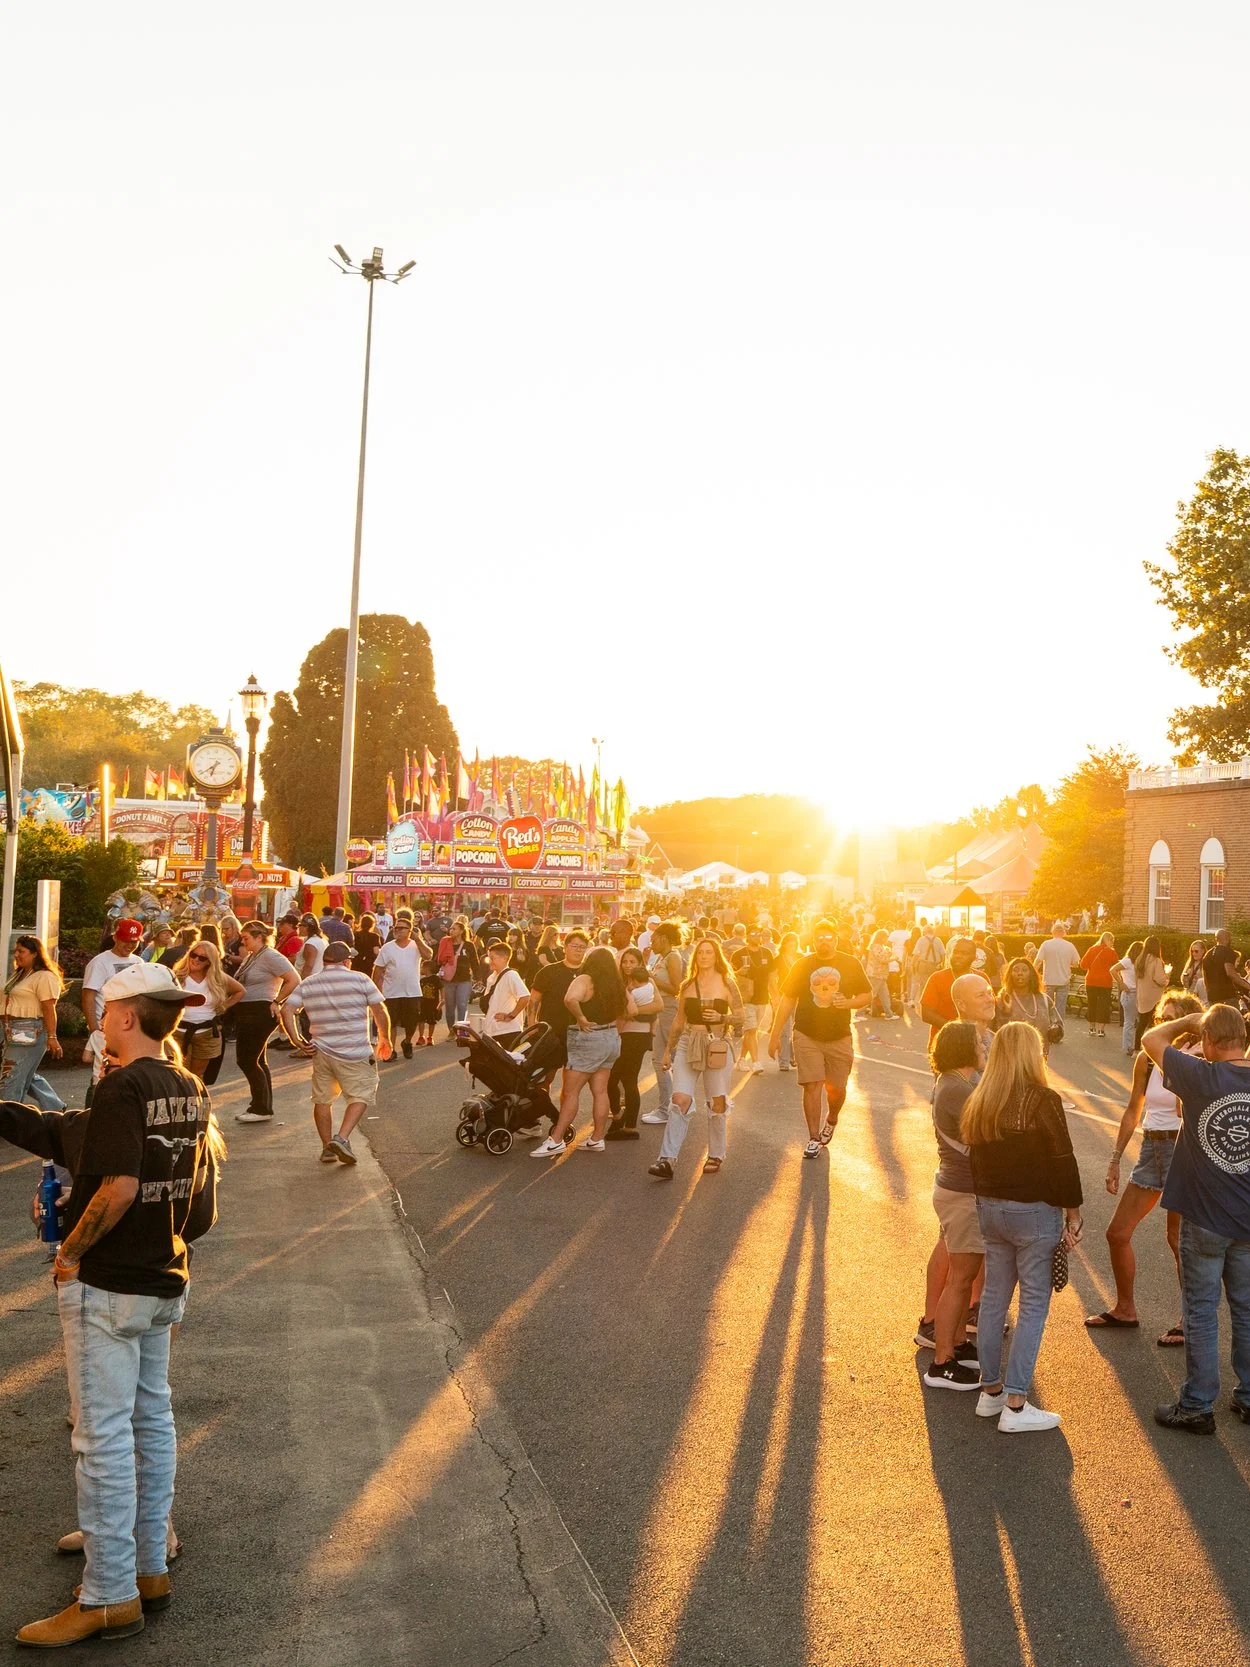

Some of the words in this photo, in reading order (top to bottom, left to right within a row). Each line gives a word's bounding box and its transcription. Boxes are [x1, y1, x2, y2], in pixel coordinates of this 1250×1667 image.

[115, 813, 142, 825] DONUT
[142, 813, 168, 826] FAMILY
[461, 817, 494, 830] Cotton
[462, 829, 493, 838] CANDY
[550, 823, 580, 836] Candy
[503, 827, 540, 847] Red's
[392, 844, 414, 853] CANDY
[506, 847, 519, 857] RED
[518, 844, 540, 855] APPLES
[456, 849, 497, 864] POPCORN
[546, 855, 582, 867] SNO-KONES
[356, 875, 382, 884] GOURMET
[382, 875, 403, 884] APPLES
[409, 875, 426, 885] COLD
[428, 876, 452, 885] DRINKS
[459, 877, 481, 885] CANDY
[482, 877, 508, 886] APPLES
[517, 878, 542, 887] COTTON
[542, 878, 563, 888] CANDY
[571, 880, 595, 888] CARAMEL
[595, 880, 614, 888] APPLES
[1209, 1133, 1227, 1158] TELLICO
